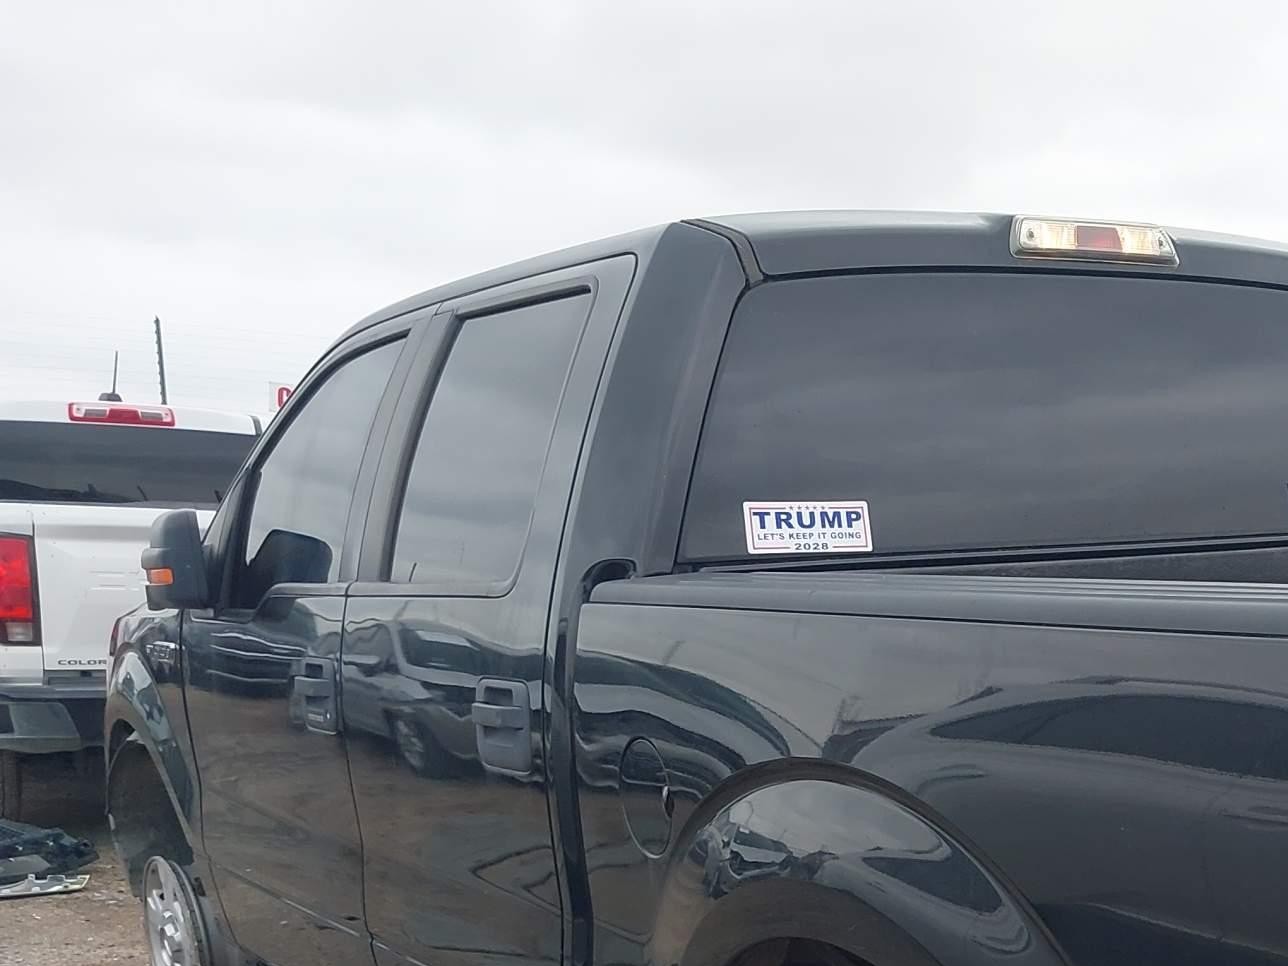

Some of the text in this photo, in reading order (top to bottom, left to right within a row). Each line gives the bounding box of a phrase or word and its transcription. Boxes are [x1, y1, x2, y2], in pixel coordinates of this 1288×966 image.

[752, 510, 862, 530] TRUMP
[757, 531, 862, 541] LET'S KEEP IT GOING
[794, 542, 829, 551] 2028
